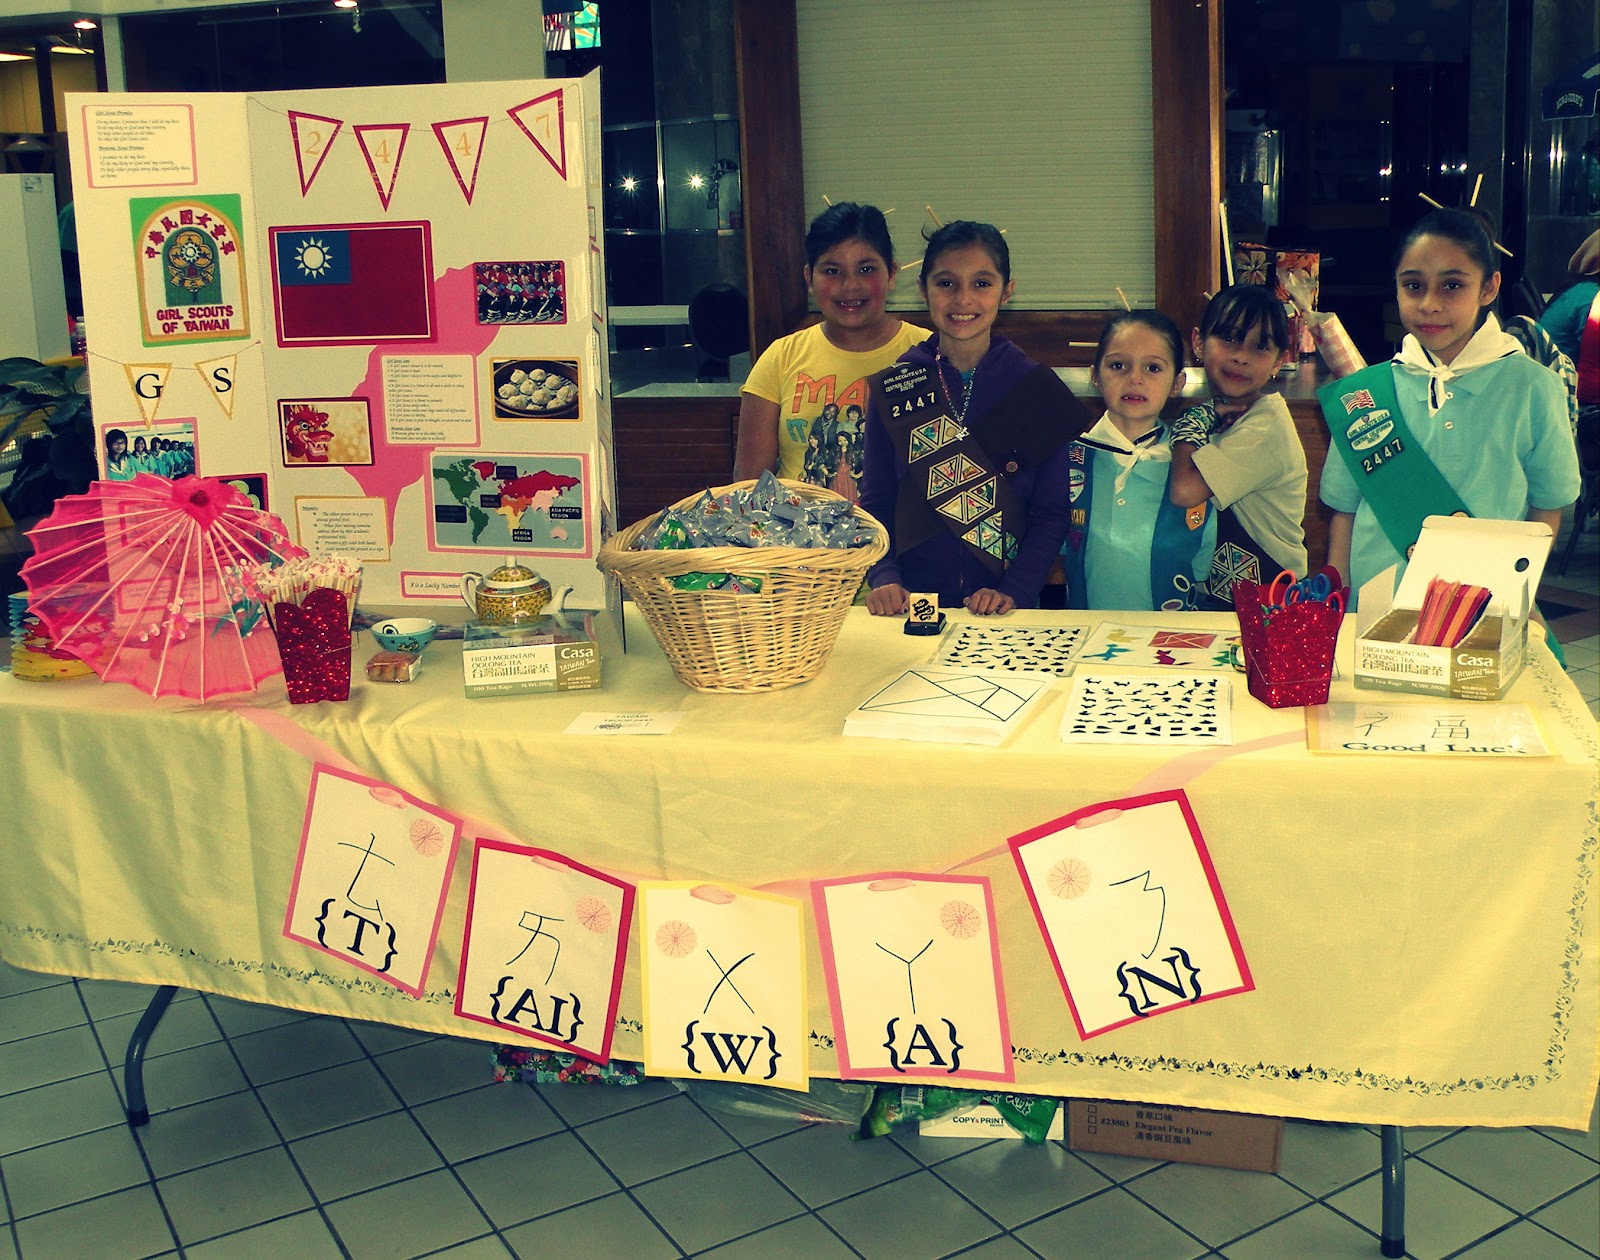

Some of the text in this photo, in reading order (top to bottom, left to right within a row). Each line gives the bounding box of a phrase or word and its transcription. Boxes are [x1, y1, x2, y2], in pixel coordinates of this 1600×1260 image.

[304, 113, 551, 164] 2 4 4 7
[156, 305, 234, 322] GIRL SCOUTS
[162, 319, 230, 334] OF TAIWAN
[135, 368, 232, 398] G S
[892, 392, 935, 417] 2447
[1364, 439, 1401, 472] 2447
[425, 582, 440, 590] Lucky
[493, 652, 536, 661] MOUNTAIN
[561, 648, 594, 659] Casa
[1362, 652, 1398, 662] OOLONG
[1385, 649, 1430, 658] MOUNTAIN
[1457, 653, 1493, 667] Casa
[560, 660, 585, 671] TAIWAN
[1454, 669, 1482, 678] TAIWAN
[1342, 742, 1526, 754] Good Luck
[1135, 1121, 1166, 1131] Elegant
[1168, 1125, 1183, 1133] Pea
[1186, 1127, 1213, 1136] Flavor
